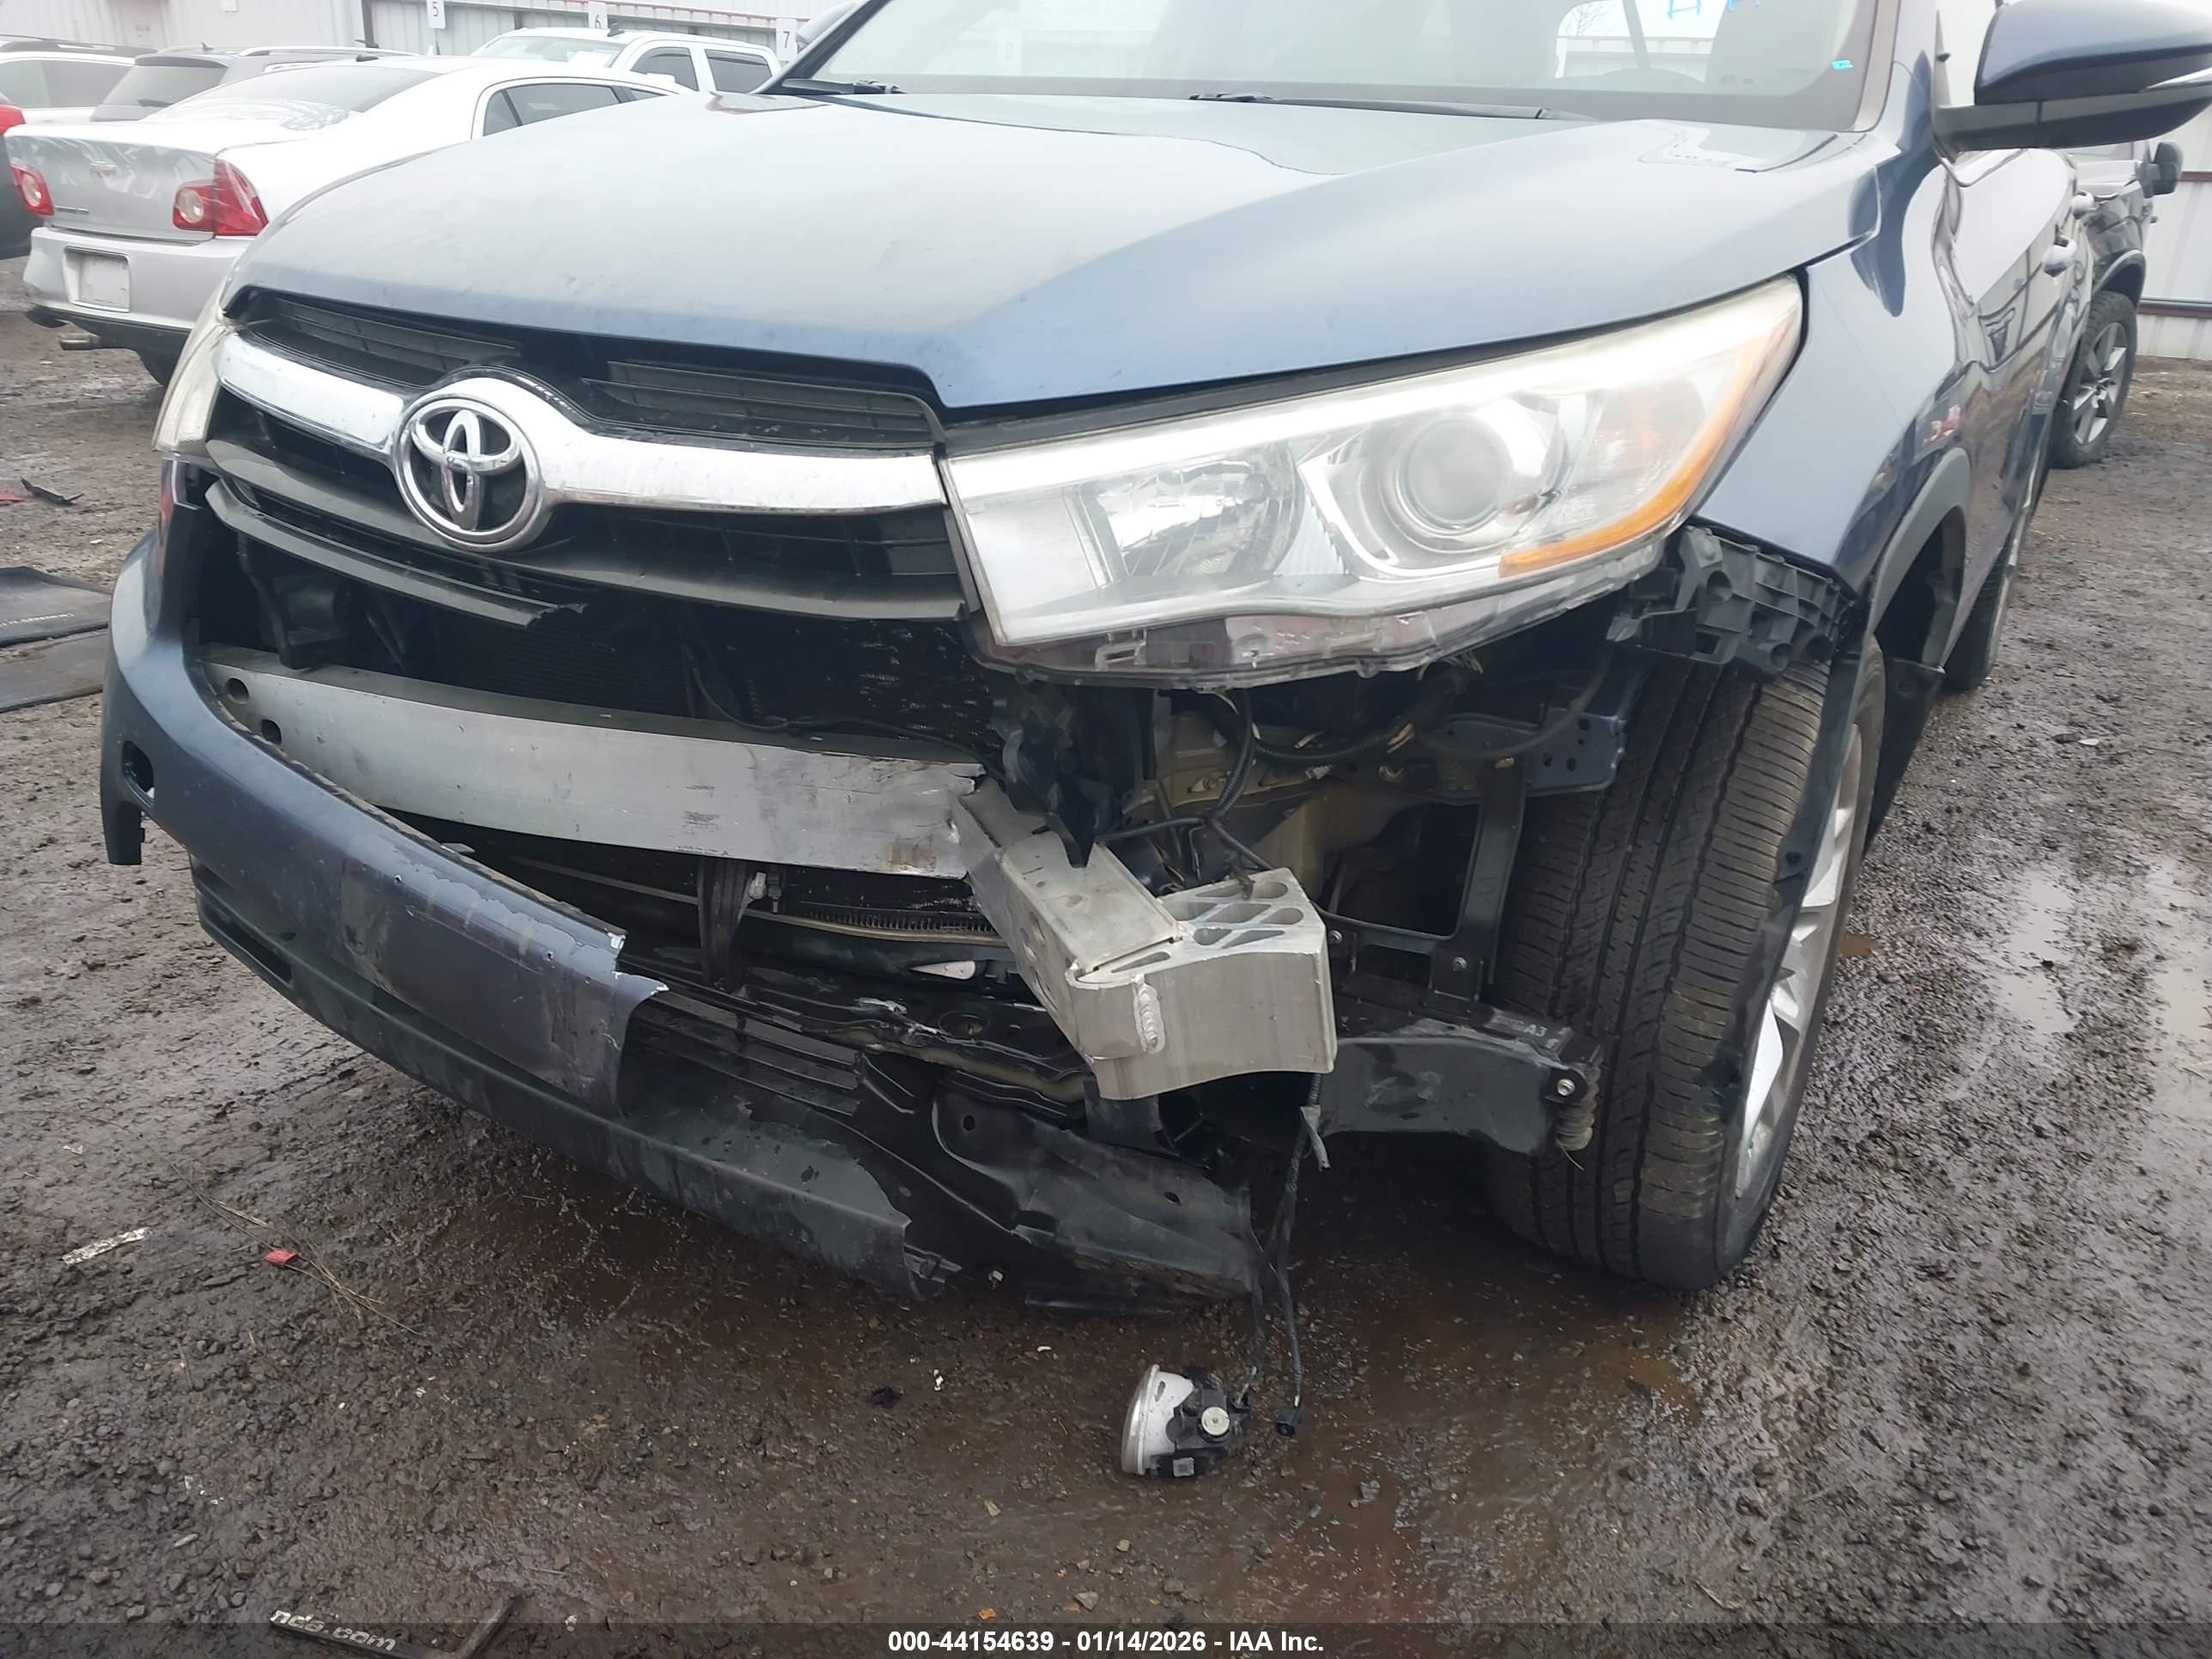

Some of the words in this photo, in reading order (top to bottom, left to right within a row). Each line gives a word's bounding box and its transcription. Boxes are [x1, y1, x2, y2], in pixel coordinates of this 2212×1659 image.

[432, 0, 440, 17] 5
[594, 14, 602, 29] 6
[782, 30, 791, 49] 7
